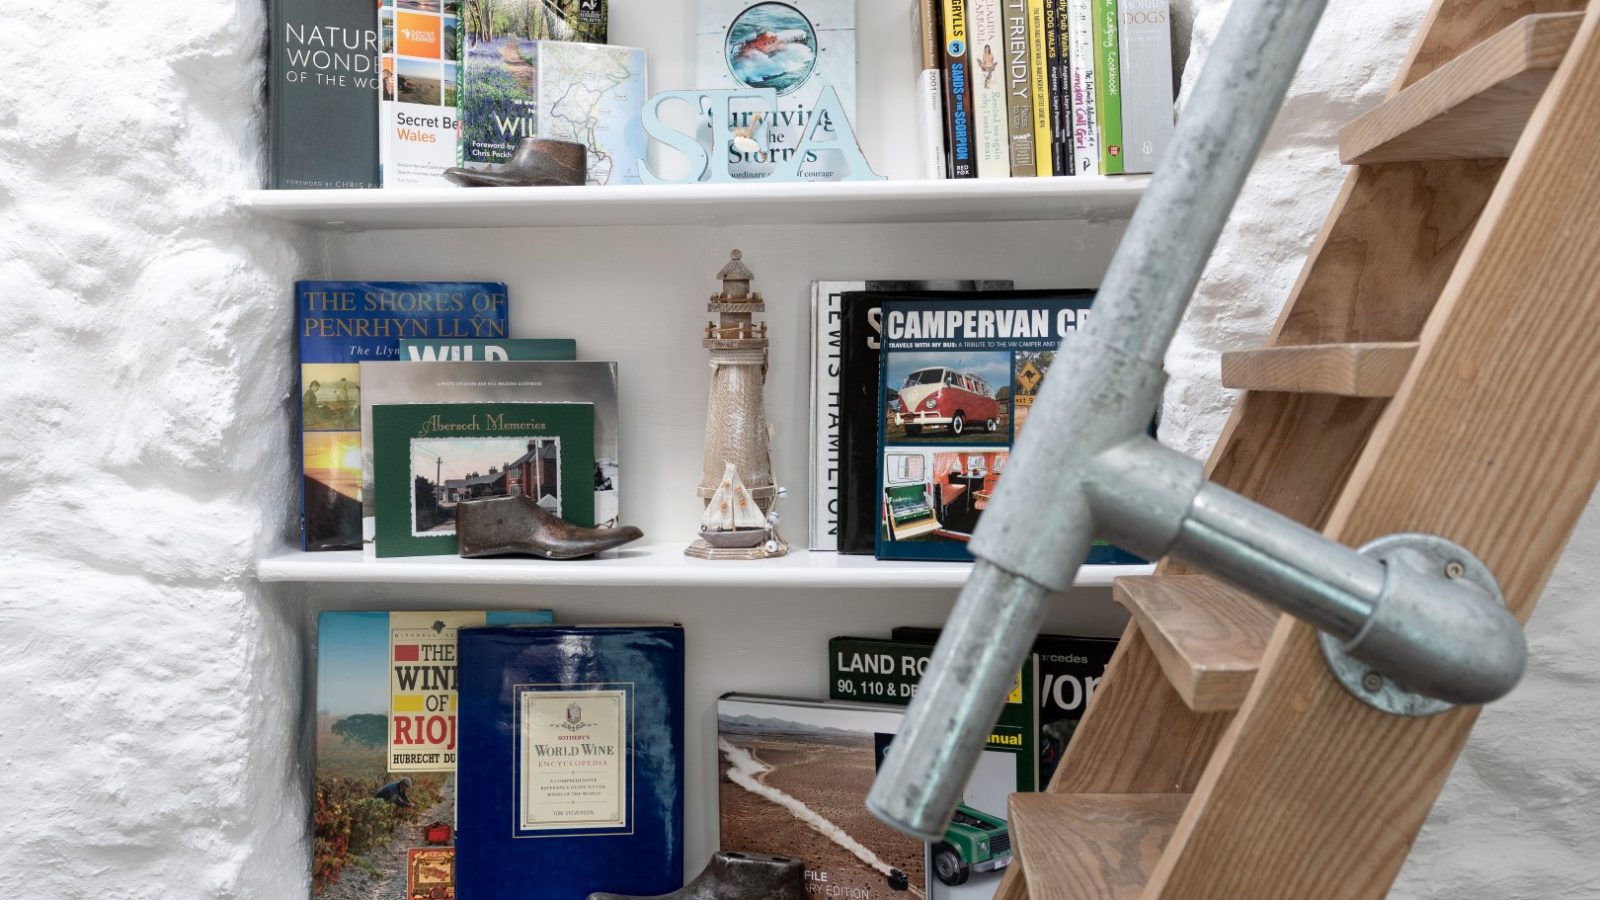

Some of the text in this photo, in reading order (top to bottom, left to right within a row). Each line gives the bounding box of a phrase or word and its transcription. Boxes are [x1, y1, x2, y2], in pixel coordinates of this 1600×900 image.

[952, 0, 964, 37] GRYLLS
[1047, 10, 1055, 28] DOG
[1060, 14, 1068, 30] Pub
[1123, 10, 1165, 25] DOGS
[1102, 11, 1117, 48] Camping
[953, 43, 960, 53] 3
[1009, 0, 1028, 99] T FRIENDLY
[1048, 30, 1056, 59] WALKS
[1061, 32, 1069, 58] Walks
[1035, 52, 1043, 66] WALES
[286, 70, 308, 83] OF
[316, 73, 347, 87] THE
[951, 63, 965, 95] SANDS
[1107, 51, 1118, 96] Cookbook
[397, 112, 440, 128] Secret
[1076, 108, 1087, 126] Call
[397, 128, 437, 143] Wales
[637, 84, 889, 186] SEA
[954, 111, 969, 160] SCORPION
[1075, 128, 1087, 149] Girl
[472, 141, 516, 151] Foreword by
[992, 138, 1002, 160] again
[335, 181, 364, 189] CHRIS
[303, 291, 505, 312] THE SHORES OF
[304, 313, 506, 337] PENRHYN LLŶN
[887, 309, 1049, 340] CAMPERVAN
[349, 345, 370, 356] The
[418, 413, 546, 437] Abersoch Memories
[827, 392, 840, 536] HAMILTON
[421, 644, 455, 662] THE
[837, 652, 895, 675] LAND
[395, 666, 458, 691] WIN
[838, 679, 856, 696] 90,
[860, 681, 884, 696] 110
[886, 682, 897, 696] &
[426, 694, 449, 712] OF
[393, 753, 441, 764] HUBRECHT
[534, 743, 615, 757] WORLD WINE
[538, 759, 608, 767] ENCYCLOPEDIA
[804, 870, 828, 882] FILE
[826, 884, 869, 899] EDITION
